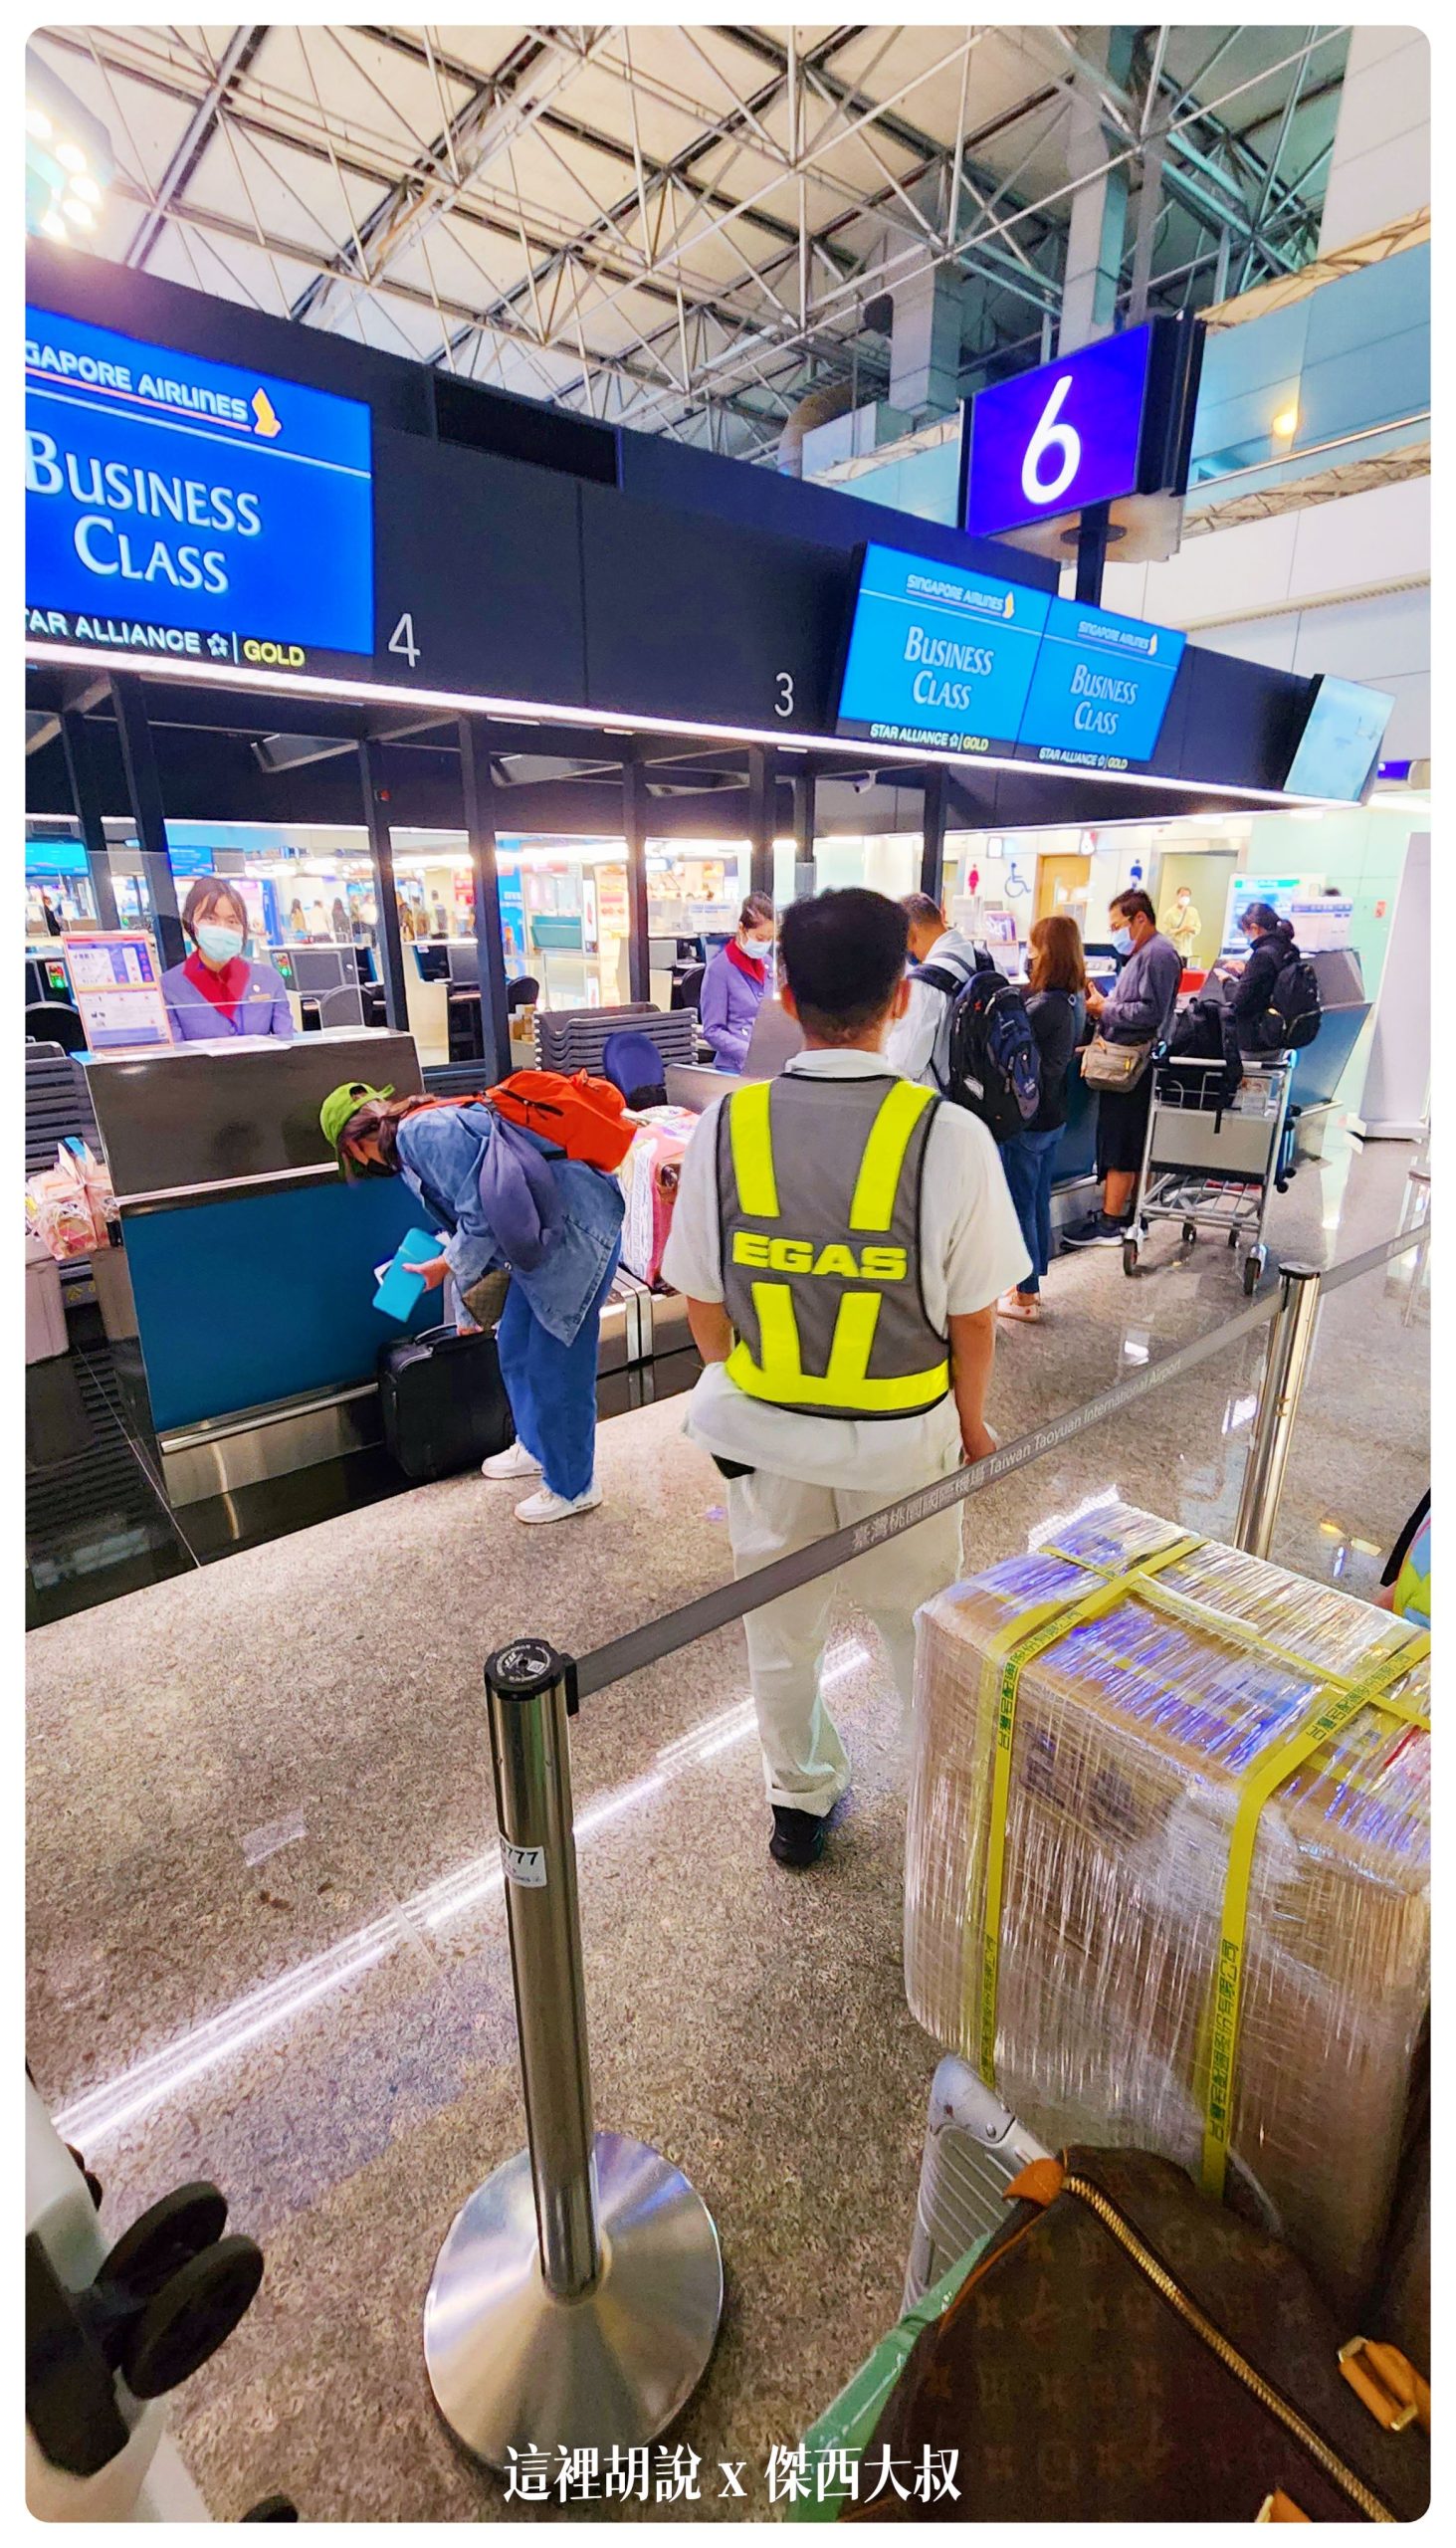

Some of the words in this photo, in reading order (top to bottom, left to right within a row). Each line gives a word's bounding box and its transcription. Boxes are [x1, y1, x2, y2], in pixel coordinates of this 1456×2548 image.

[138, 373, 248, 422] AIRLINES
[1021, 375, 1082, 505] 6
[74, 515, 229, 594] CLASS
[907, 574, 963, 600] SINGAPORE
[964, 589, 1004, 611] AIRLINES
[26, 607, 70, 636] AR
[75, 615, 201, 655] ALLIANCE
[243, 639, 306, 667] GOLD
[387, 613, 421, 667] 4
[1078, 621, 1120, 642] SINGAPORE
[774, 672, 794, 717] 3
[870, 724, 899, 740] STAR
[899, 728, 951, 746] ALLIANCE
[962, 736, 989, 751] GOLD
[1039, 747, 1061, 760] STAR
[1061, 750, 1099, 766] ALLIANCE
[1108, 756, 1129, 769] GOLD
[732, 1231, 908, 1281] EGAS
[989, 1444, 1031, 1476] Taiwan
[1034, 1416, 1082, 1451] Taoyuan
[1084, 1375, 1147, 1423] International
[1148, 1358, 1181, 1388] Airport
